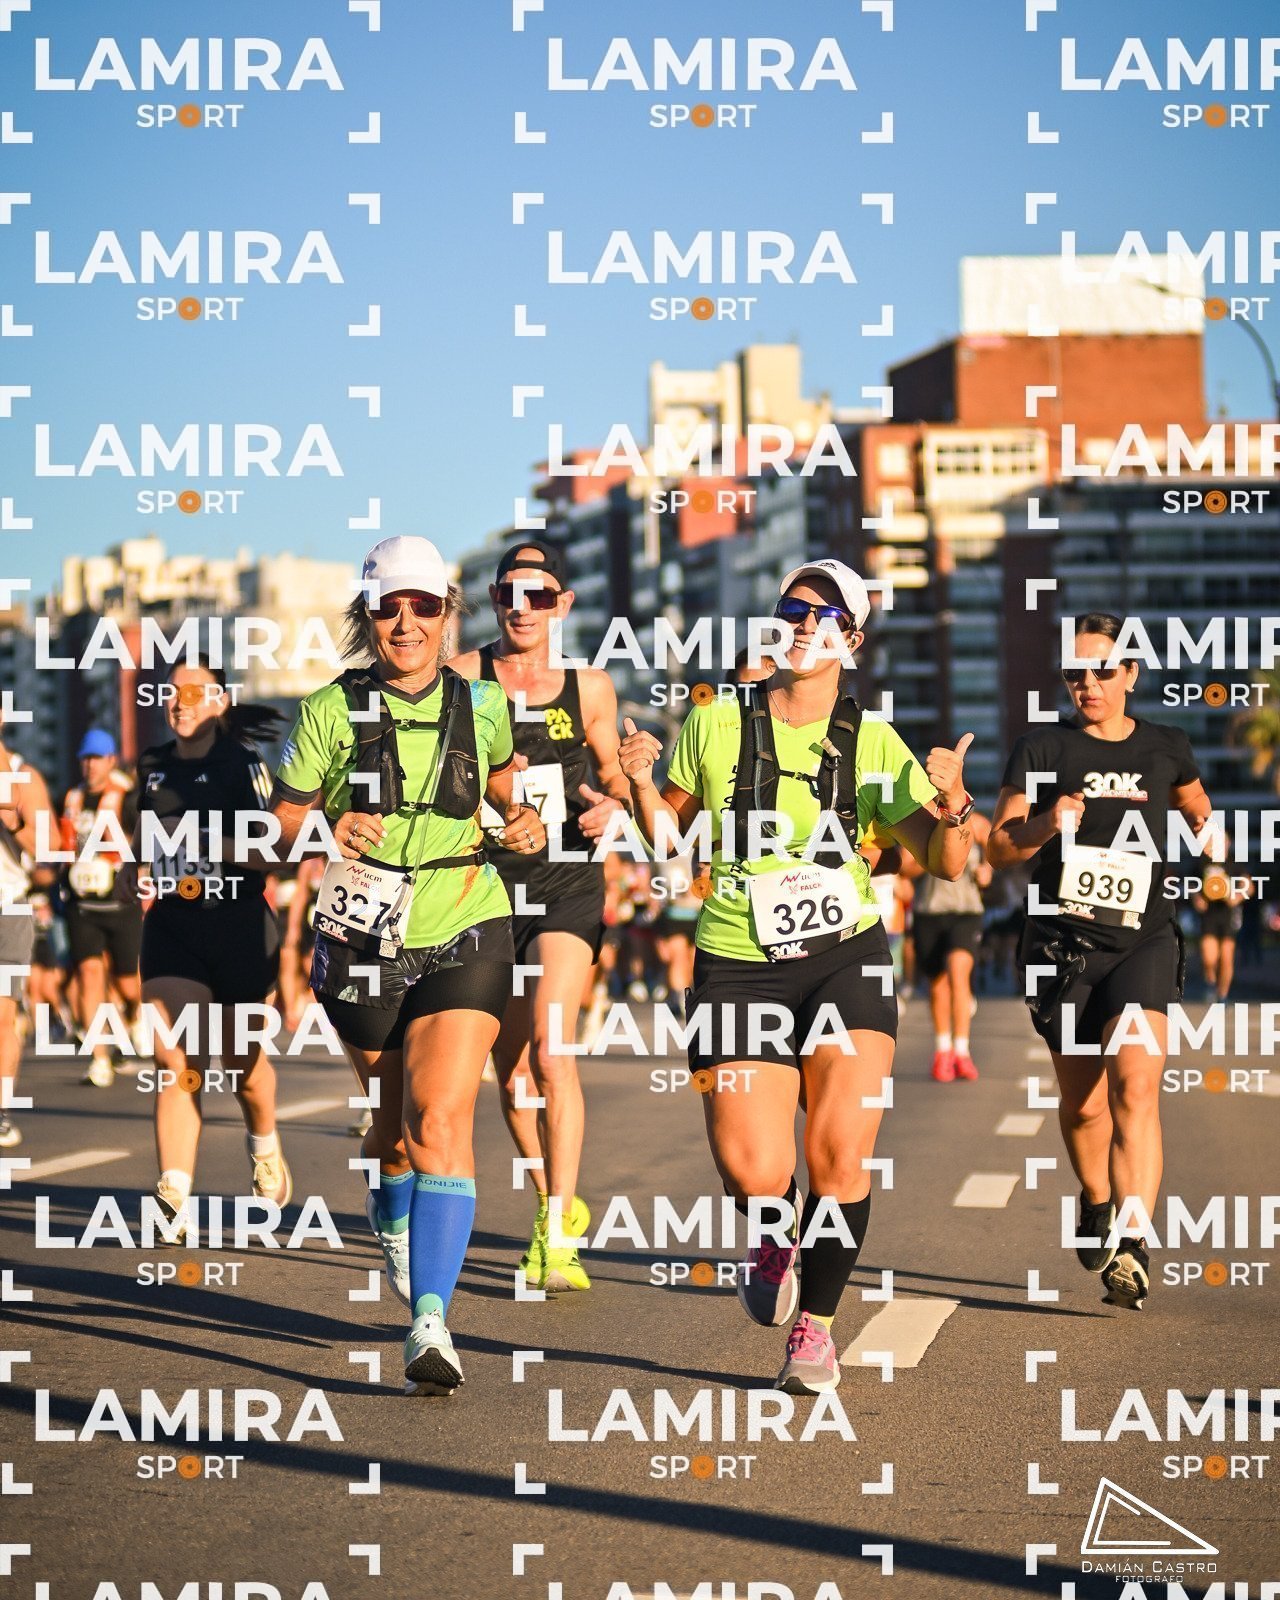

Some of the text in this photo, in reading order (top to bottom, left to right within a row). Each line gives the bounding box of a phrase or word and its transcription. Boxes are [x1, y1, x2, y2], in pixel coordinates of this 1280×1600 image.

[1082, 771, 1143, 798] 30K
[1077, 871, 1134, 904] 939
[331, 885, 392, 930] 327
[773, 894, 844, 936] 326
